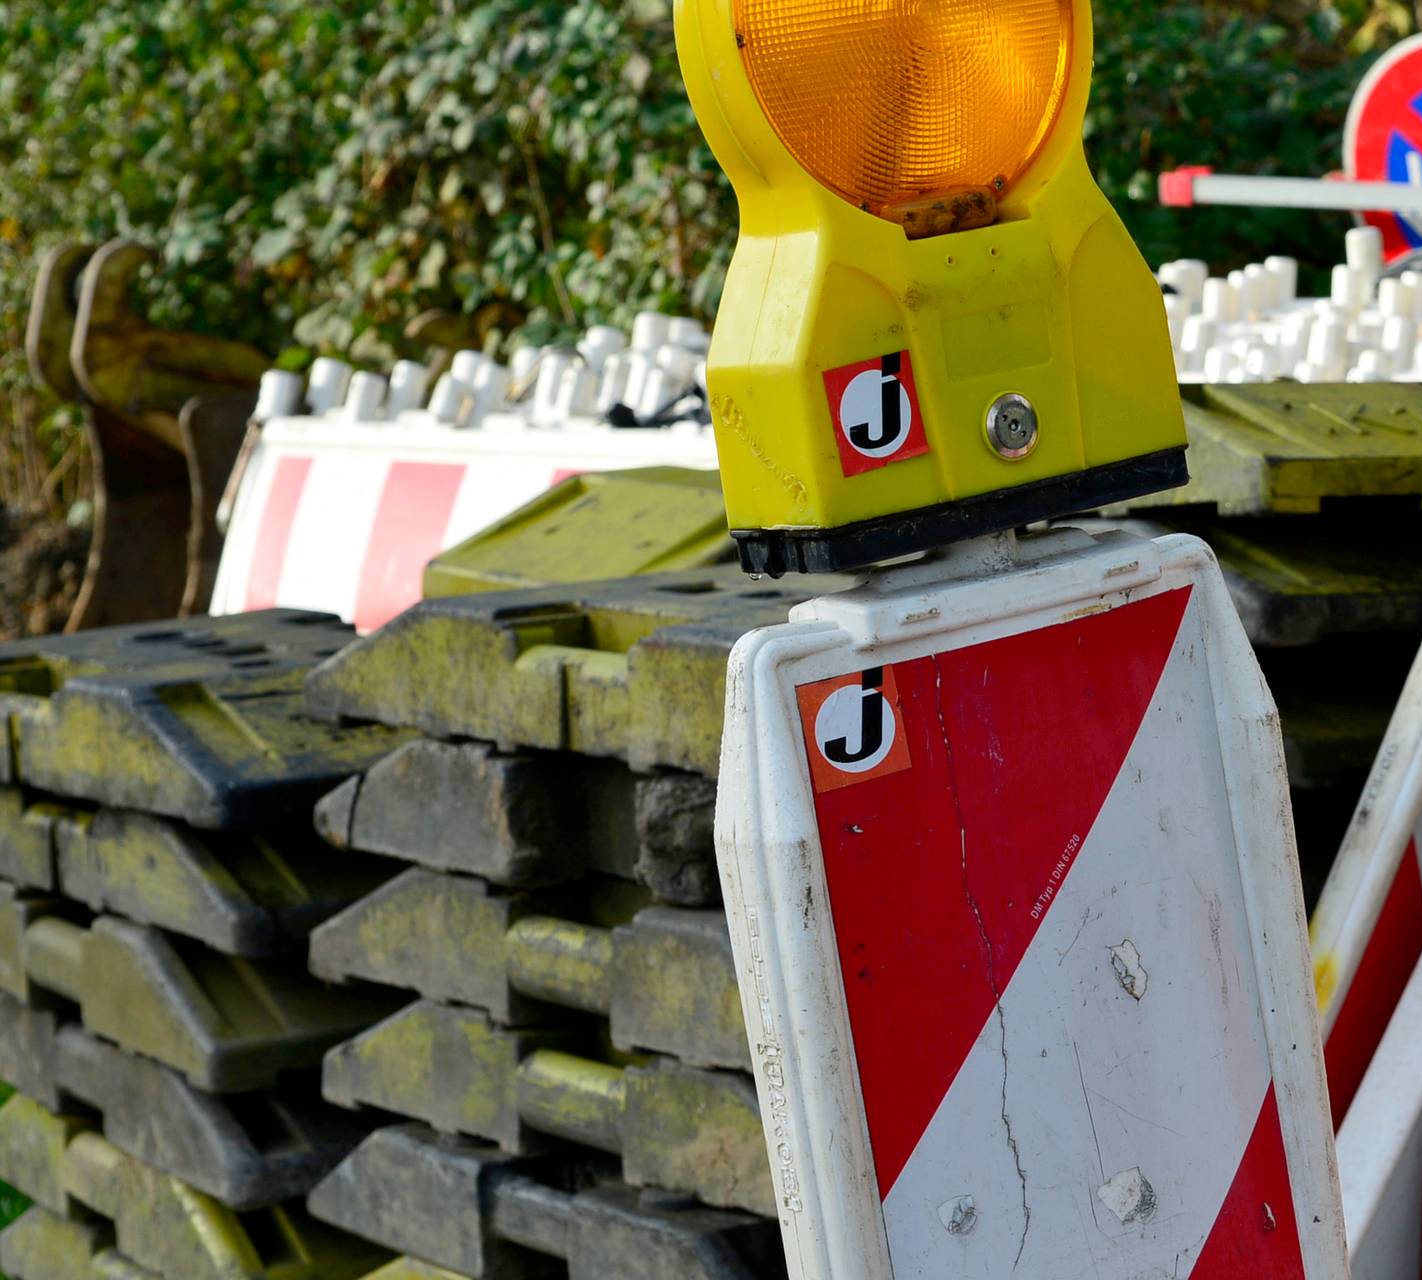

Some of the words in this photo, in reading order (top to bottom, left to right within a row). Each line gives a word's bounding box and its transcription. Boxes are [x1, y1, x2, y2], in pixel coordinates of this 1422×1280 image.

[1039, 886, 1054, 902] Typ
[1052, 861, 1066, 880] DIN
[1061, 833, 1080, 862] 67520
